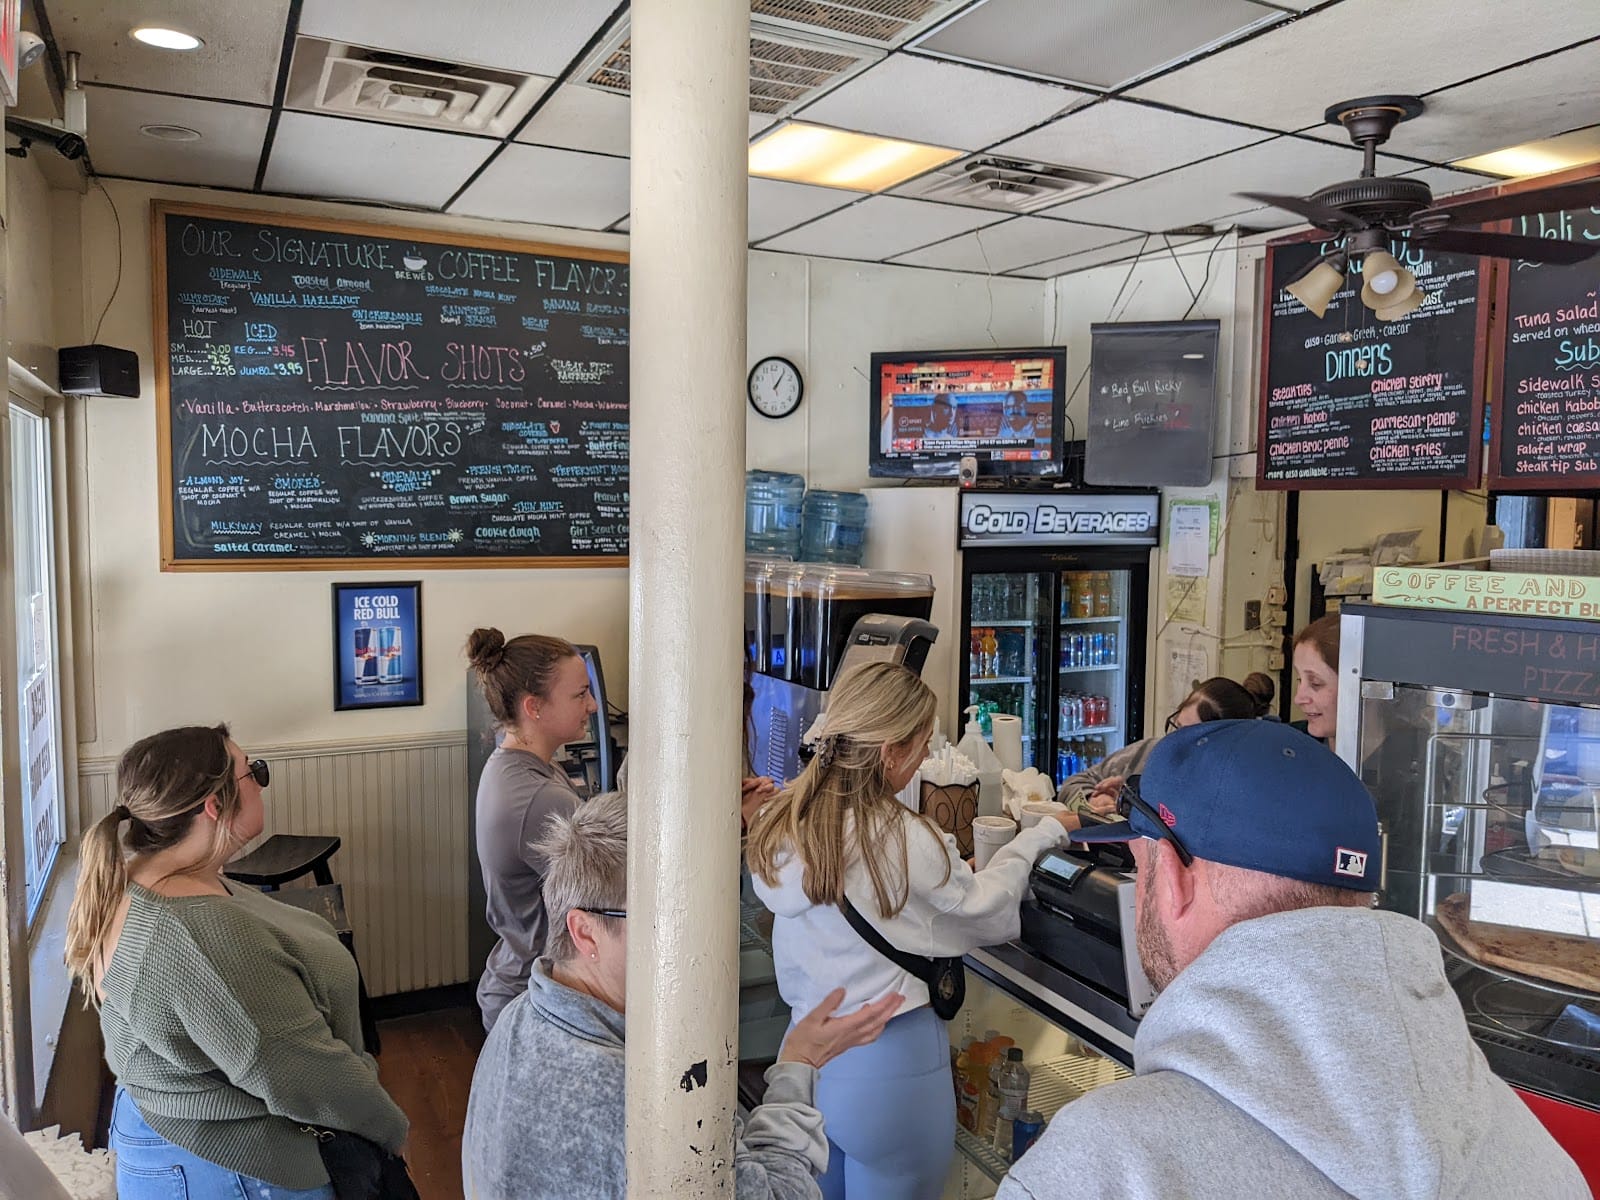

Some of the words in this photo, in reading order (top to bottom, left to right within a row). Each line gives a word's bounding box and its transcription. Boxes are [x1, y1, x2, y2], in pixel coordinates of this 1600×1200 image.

[181, 223, 241, 260] OUR
[252, 229, 394, 270] SIGNATURE
[438, 250, 520, 283] COFFEE
[208, 266, 263, 281] SIDEWALK
[249, 290, 297, 306] VANILLA
[543, 298, 581, 312] BANANA
[1514, 312, 1551, 329] Tuna
[1555, 301, 1598, 325] salad
[182, 319, 217, 337] HOT
[243, 322, 278, 339] ICED
[1512, 328, 1551, 343] served
[1554, 325, 1568, 337] on
[1573, 322, 1600, 336] whea
[301, 336, 430, 385] FLAVOR
[441, 342, 526, 383] SHOTS
[1326, 343, 1392, 381] Dinners
[1132, 381, 1151, 394] Bull
[1517, 373, 1585, 394] Sidewalk
[185, 398, 235, 416] Vanilla
[241, 401, 310, 414] Butterscotch
[380, 398, 438, 413] Strawberry
[361, 412, 397, 425] Banana
[1565, 418, 1600, 435] caesa
[202, 423, 318, 458] MOCHA
[337, 422, 462, 458] FLAVORS
[1557, 440, 1587, 456] wrap
[185, 475, 225, 486] ALMOND
[449, 494, 478, 506] Brown
[211, 520, 263, 532] MILKYWAY
[967, 504, 1030, 535] COLD
[1033, 504, 1151, 535] BEVERAGES
[508, 525, 542, 543] dough
[214, 542, 251, 553] salted
[1382, 571, 1508, 595] COFFEE
[1518, 577, 1588, 600] AND
[354, 596, 370, 609] ICE
[372, 594, 399, 608] COLD
[1466, 595, 1479, 609] A
[1483, 596, 1574, 616] PERFECT
[354, 608, 374, 620] RED
[376, 607, 401, 619] BULL
[1452, 625, 1540, 657] FRESH
[1548, 632, 1567, 660] &
